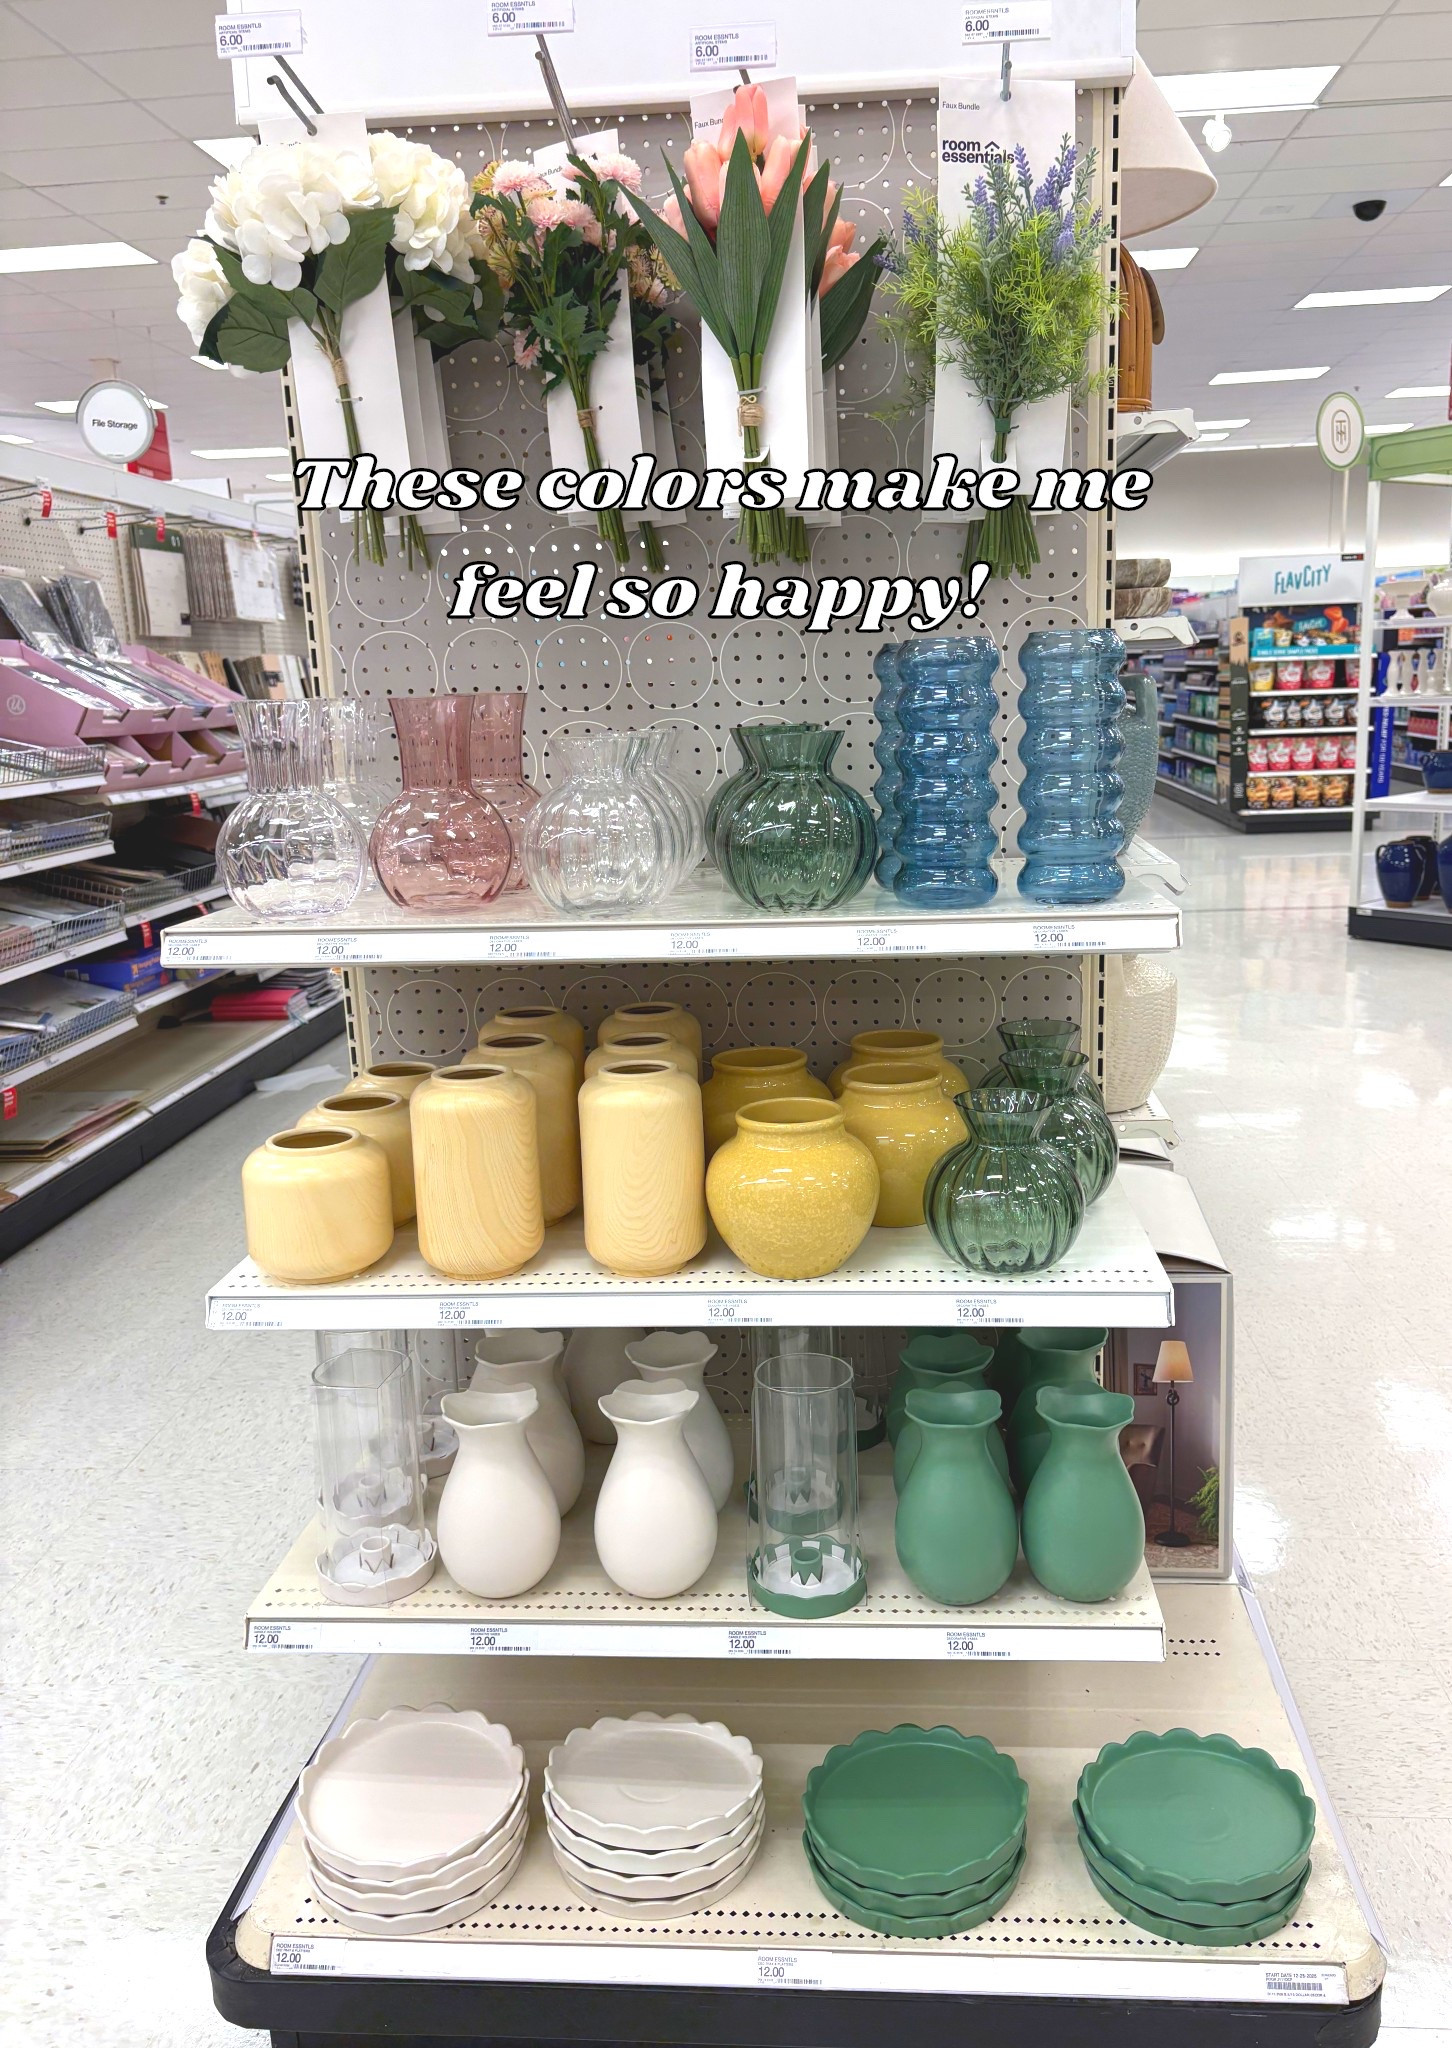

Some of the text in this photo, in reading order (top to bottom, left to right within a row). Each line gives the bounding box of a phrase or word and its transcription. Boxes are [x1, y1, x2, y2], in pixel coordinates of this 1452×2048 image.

[492, 12, 515, 23] 6.00
[966, 20, 989, 32] 6.00
[220, 35, 242, 46] 6.00
[696, 45, 718, 57] 6.00
[942, 101, 980, 110] Faux Bundle
[694, 121, 709, 129] Faux
[942, 140, 980, 152] room
[942, 148, 1015, 164] essentials
[92, 419, 138, 430] File Storage
[858, 938, 885, 946] 12.00
[1035, 933, 1063, 942] 12.00
[490, 944, 517, 952] 12.00
[672, 940, 698, 949] 12.00
[168, 947, 194, 955] 12.00
[317, 946, 344, 954] 12.00
[222, 1312, 247, 1320] 12.00
[440, 1310, 465, 1319] 12.00
[709, 1308, 734, 1317] 12.00
[958, 1308, 984, 1317] 12.00
[254, 1634, 278, 1643] 12.00
[471, 1636, 495, 1645] 12.00
[729, 1639, 754, 1648] 12.00
[948, 1641, 973, 1650] 12.00
[276, 1953, 301, 1963] 12.00
[759, 1967, 784, 1977] 12.00
